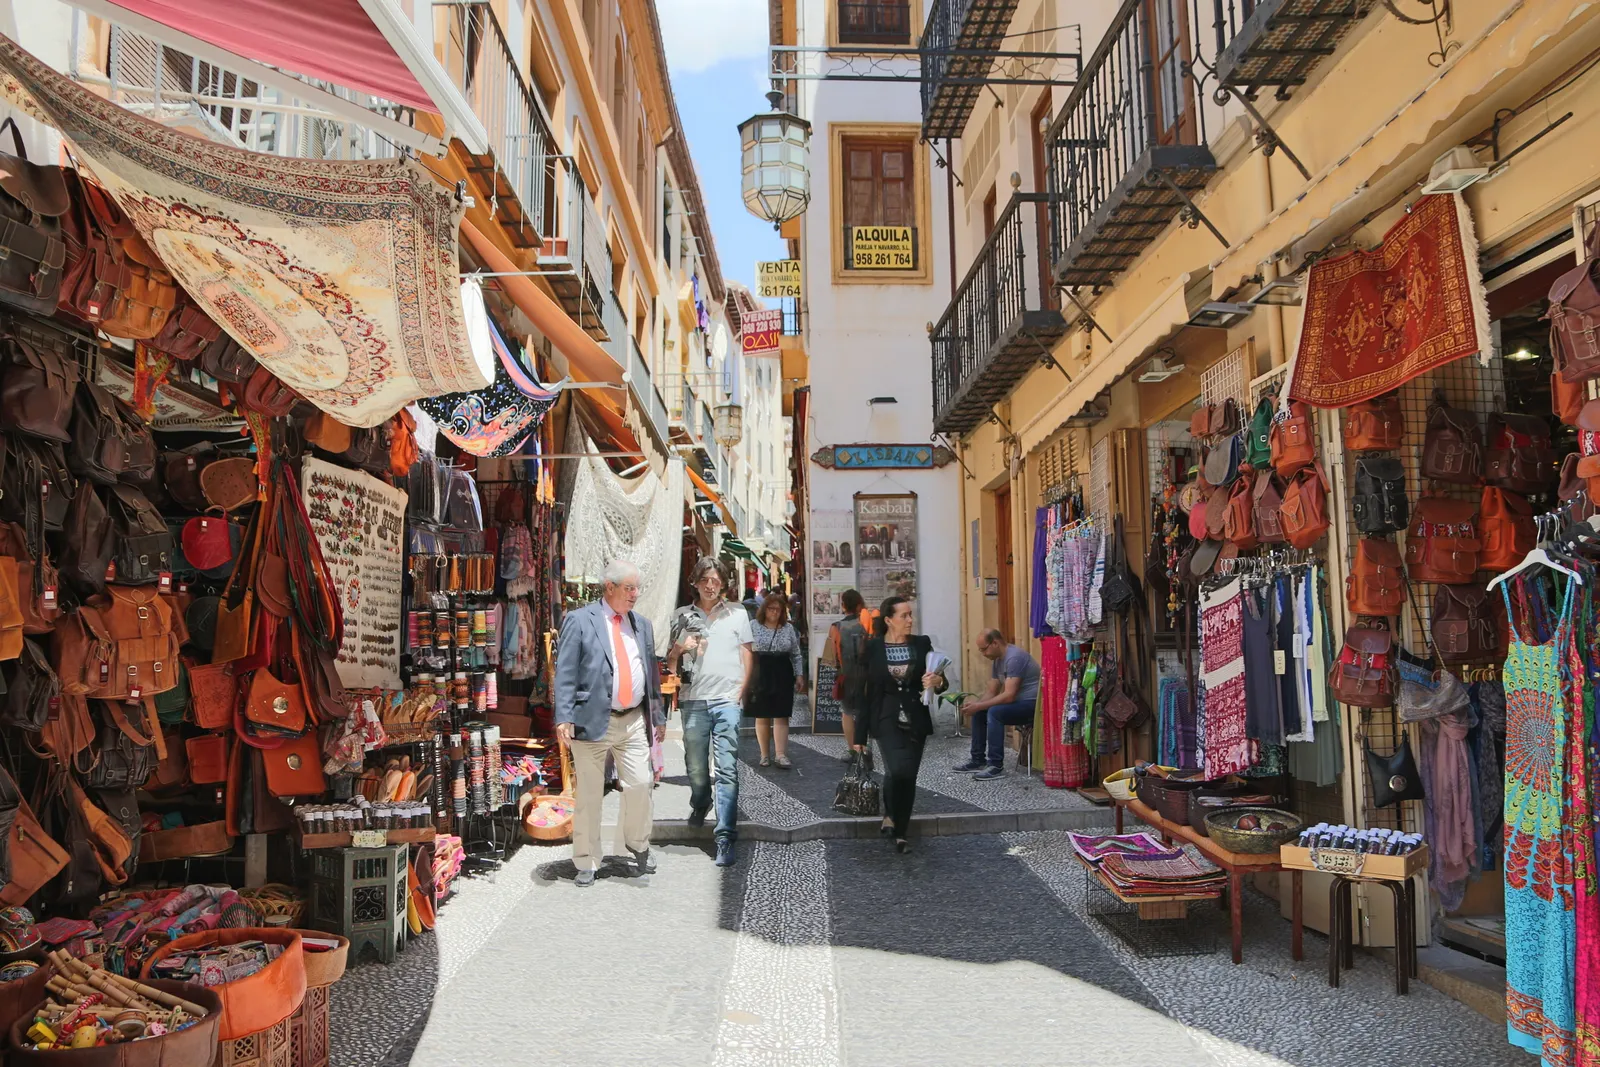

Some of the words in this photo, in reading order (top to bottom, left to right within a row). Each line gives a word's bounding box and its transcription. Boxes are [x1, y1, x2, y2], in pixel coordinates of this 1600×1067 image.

[855, 228, 910, 242] ALQUILA
[855, 253, 872, 265] 958
[875, 253, 890, 265] 261
[894, 253, 910, 265] 764
[757, 261, 800, 273] VENTA
[757, 285, 800, 297] 261764
[743, 311, 780, 323] VENDE
[852, 447, 915, 465] KASBAH
[858, 500, 913, 514] Kasbah
